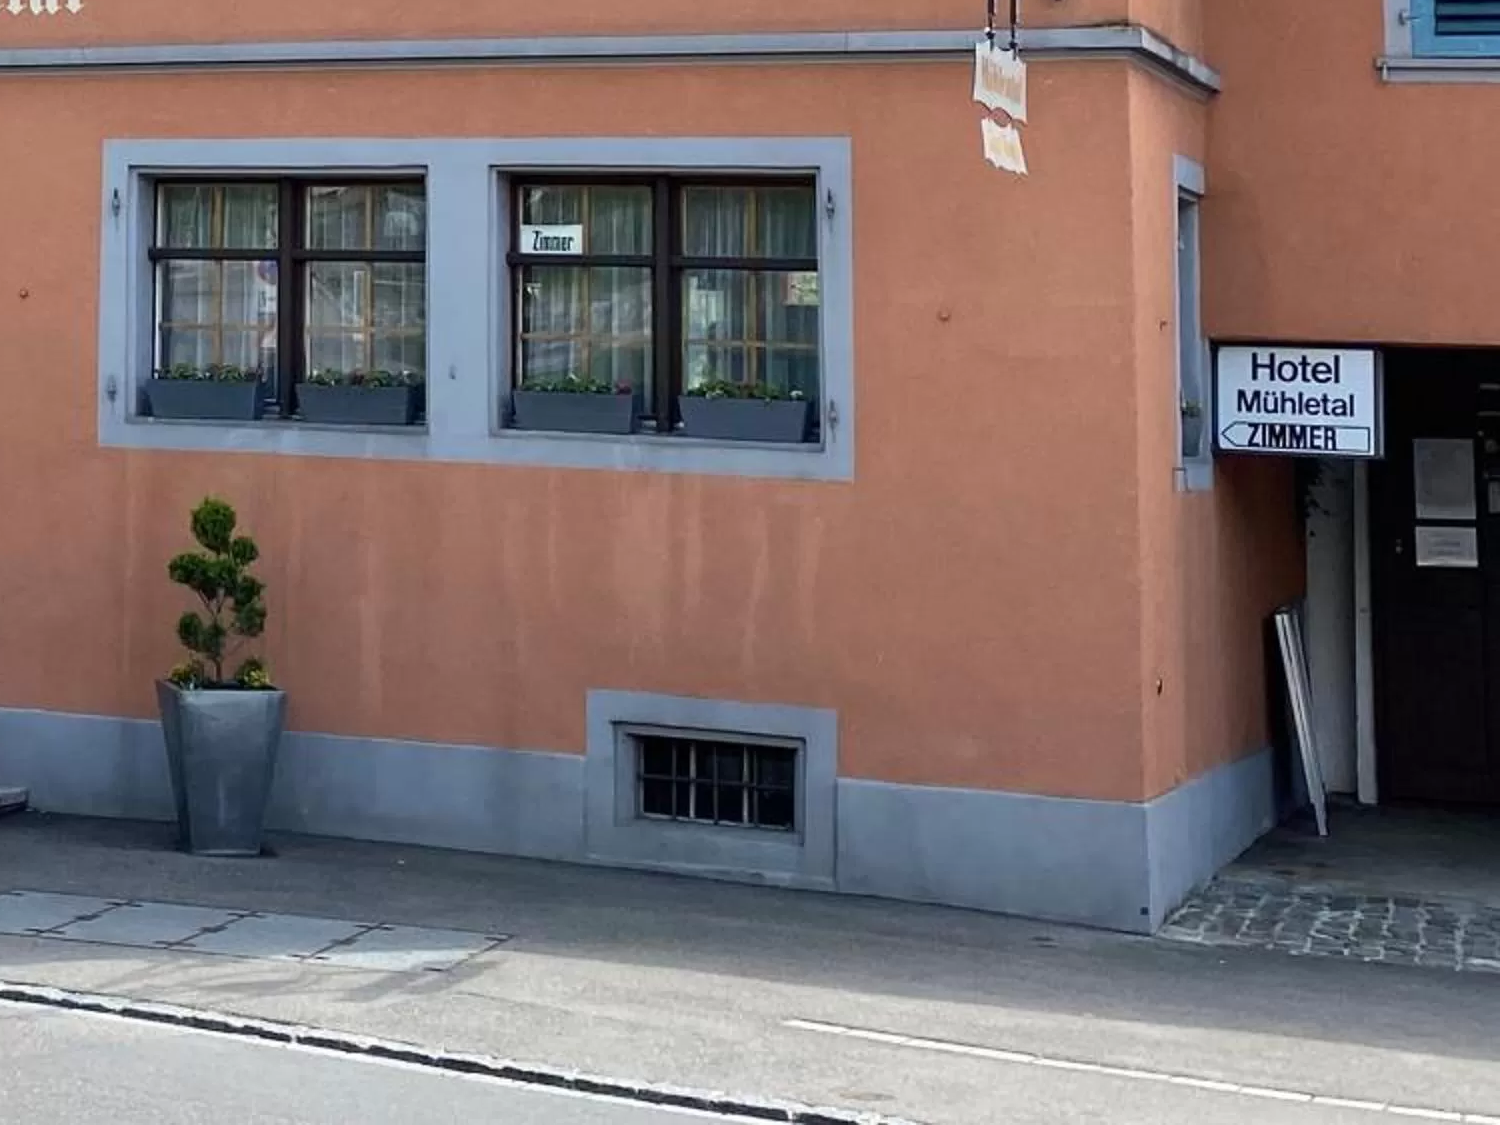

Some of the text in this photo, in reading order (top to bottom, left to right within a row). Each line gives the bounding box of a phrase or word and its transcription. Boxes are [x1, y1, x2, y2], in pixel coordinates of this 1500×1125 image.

[532, 230, 575, 251] Zimmer
[1251, 353, 1341, 383] Hotel
[1237, 389, 1355, 417] Mühletal
[1247, 424, 1337, 451] ZIMMER
